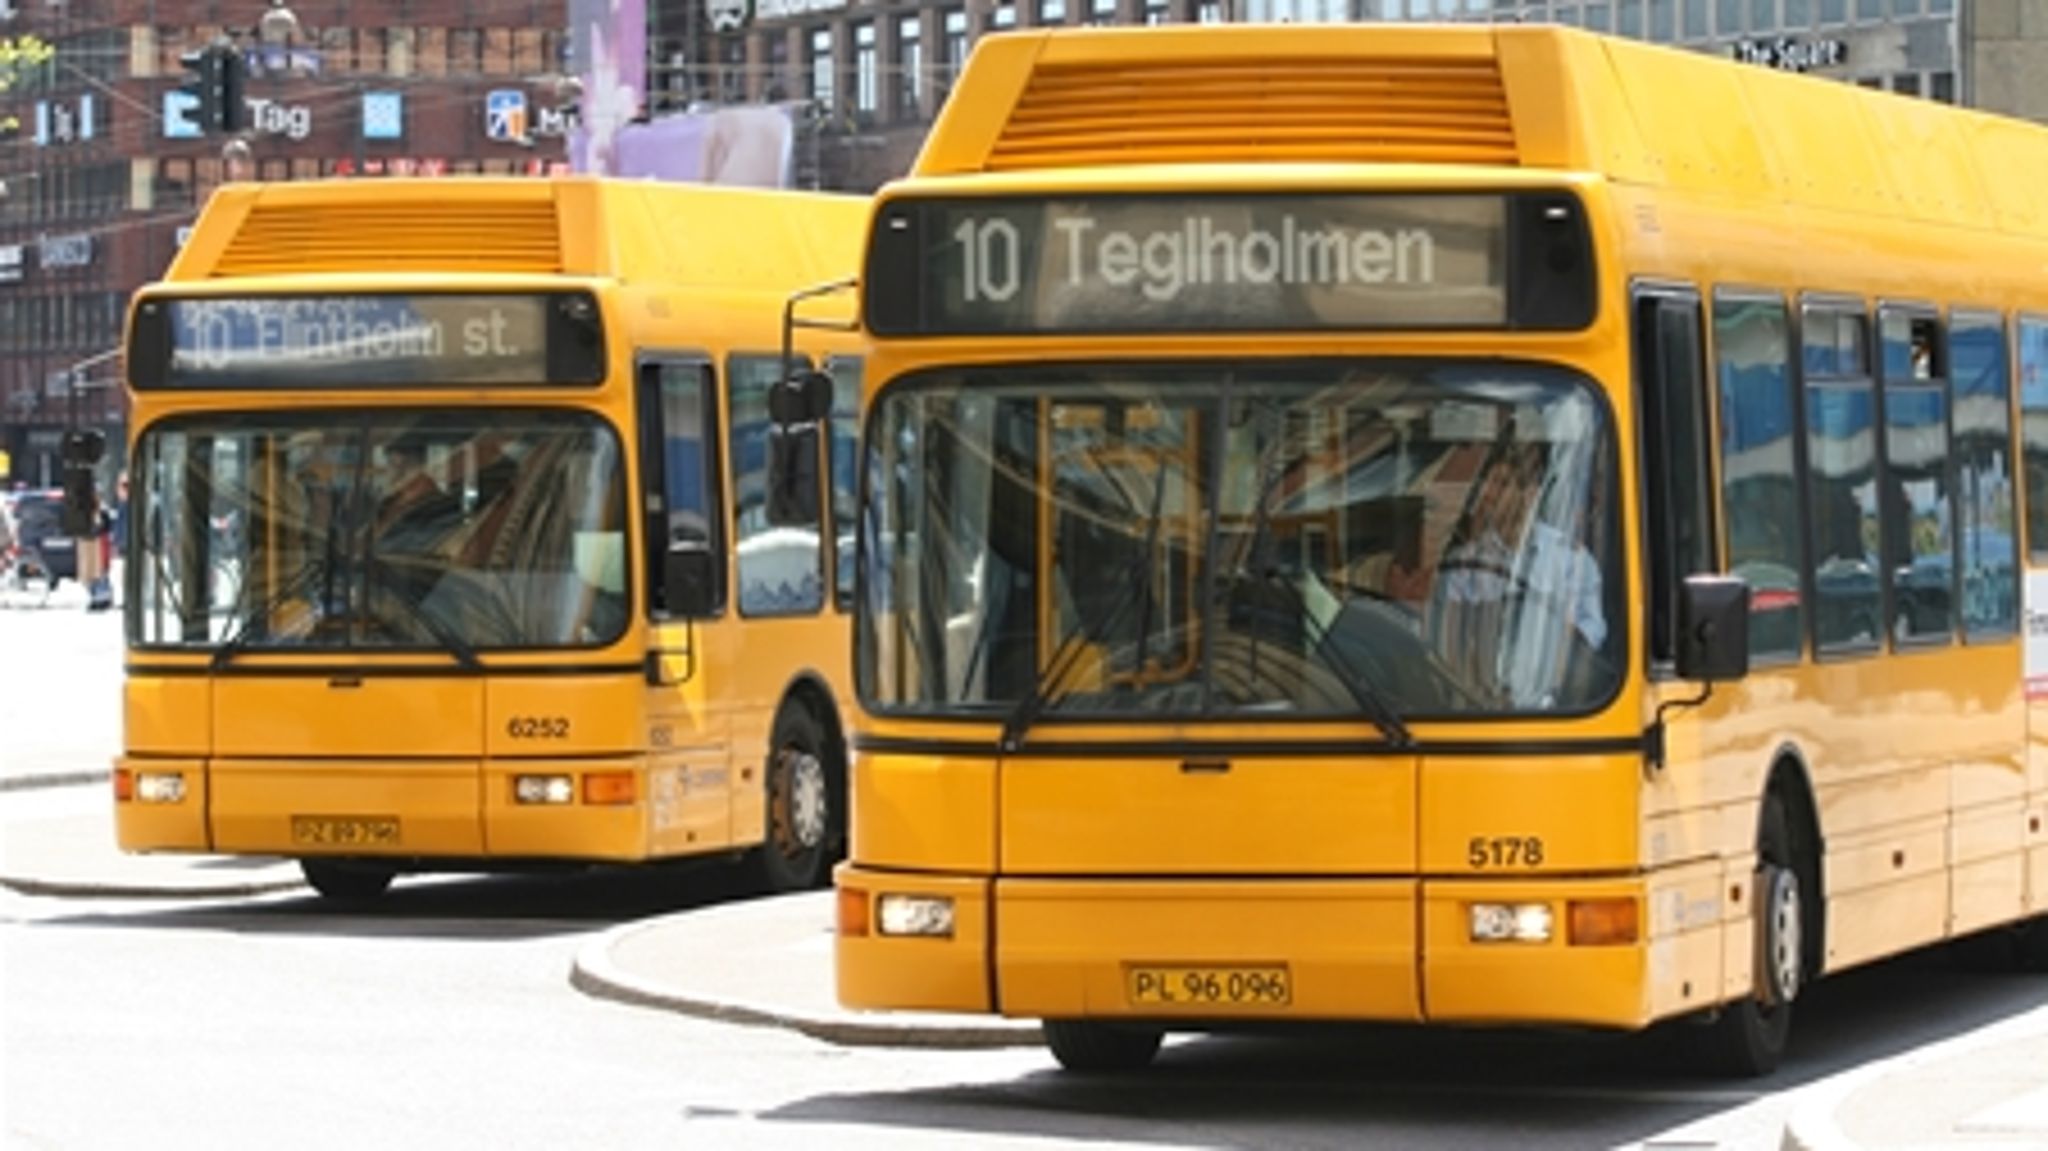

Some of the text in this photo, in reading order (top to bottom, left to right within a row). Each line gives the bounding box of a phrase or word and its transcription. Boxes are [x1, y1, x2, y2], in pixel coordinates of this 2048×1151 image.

[954, 215, 1434, 301] 10 Teglholmen
[258, 309, 444, 358] Flntholm
[462, 309, 519, 356] st.
[507, 716, 570, 739] 6252
[1468, 836, 1544, 868] 5178
[1136, 972, 1285, 1001] PL 96 096
